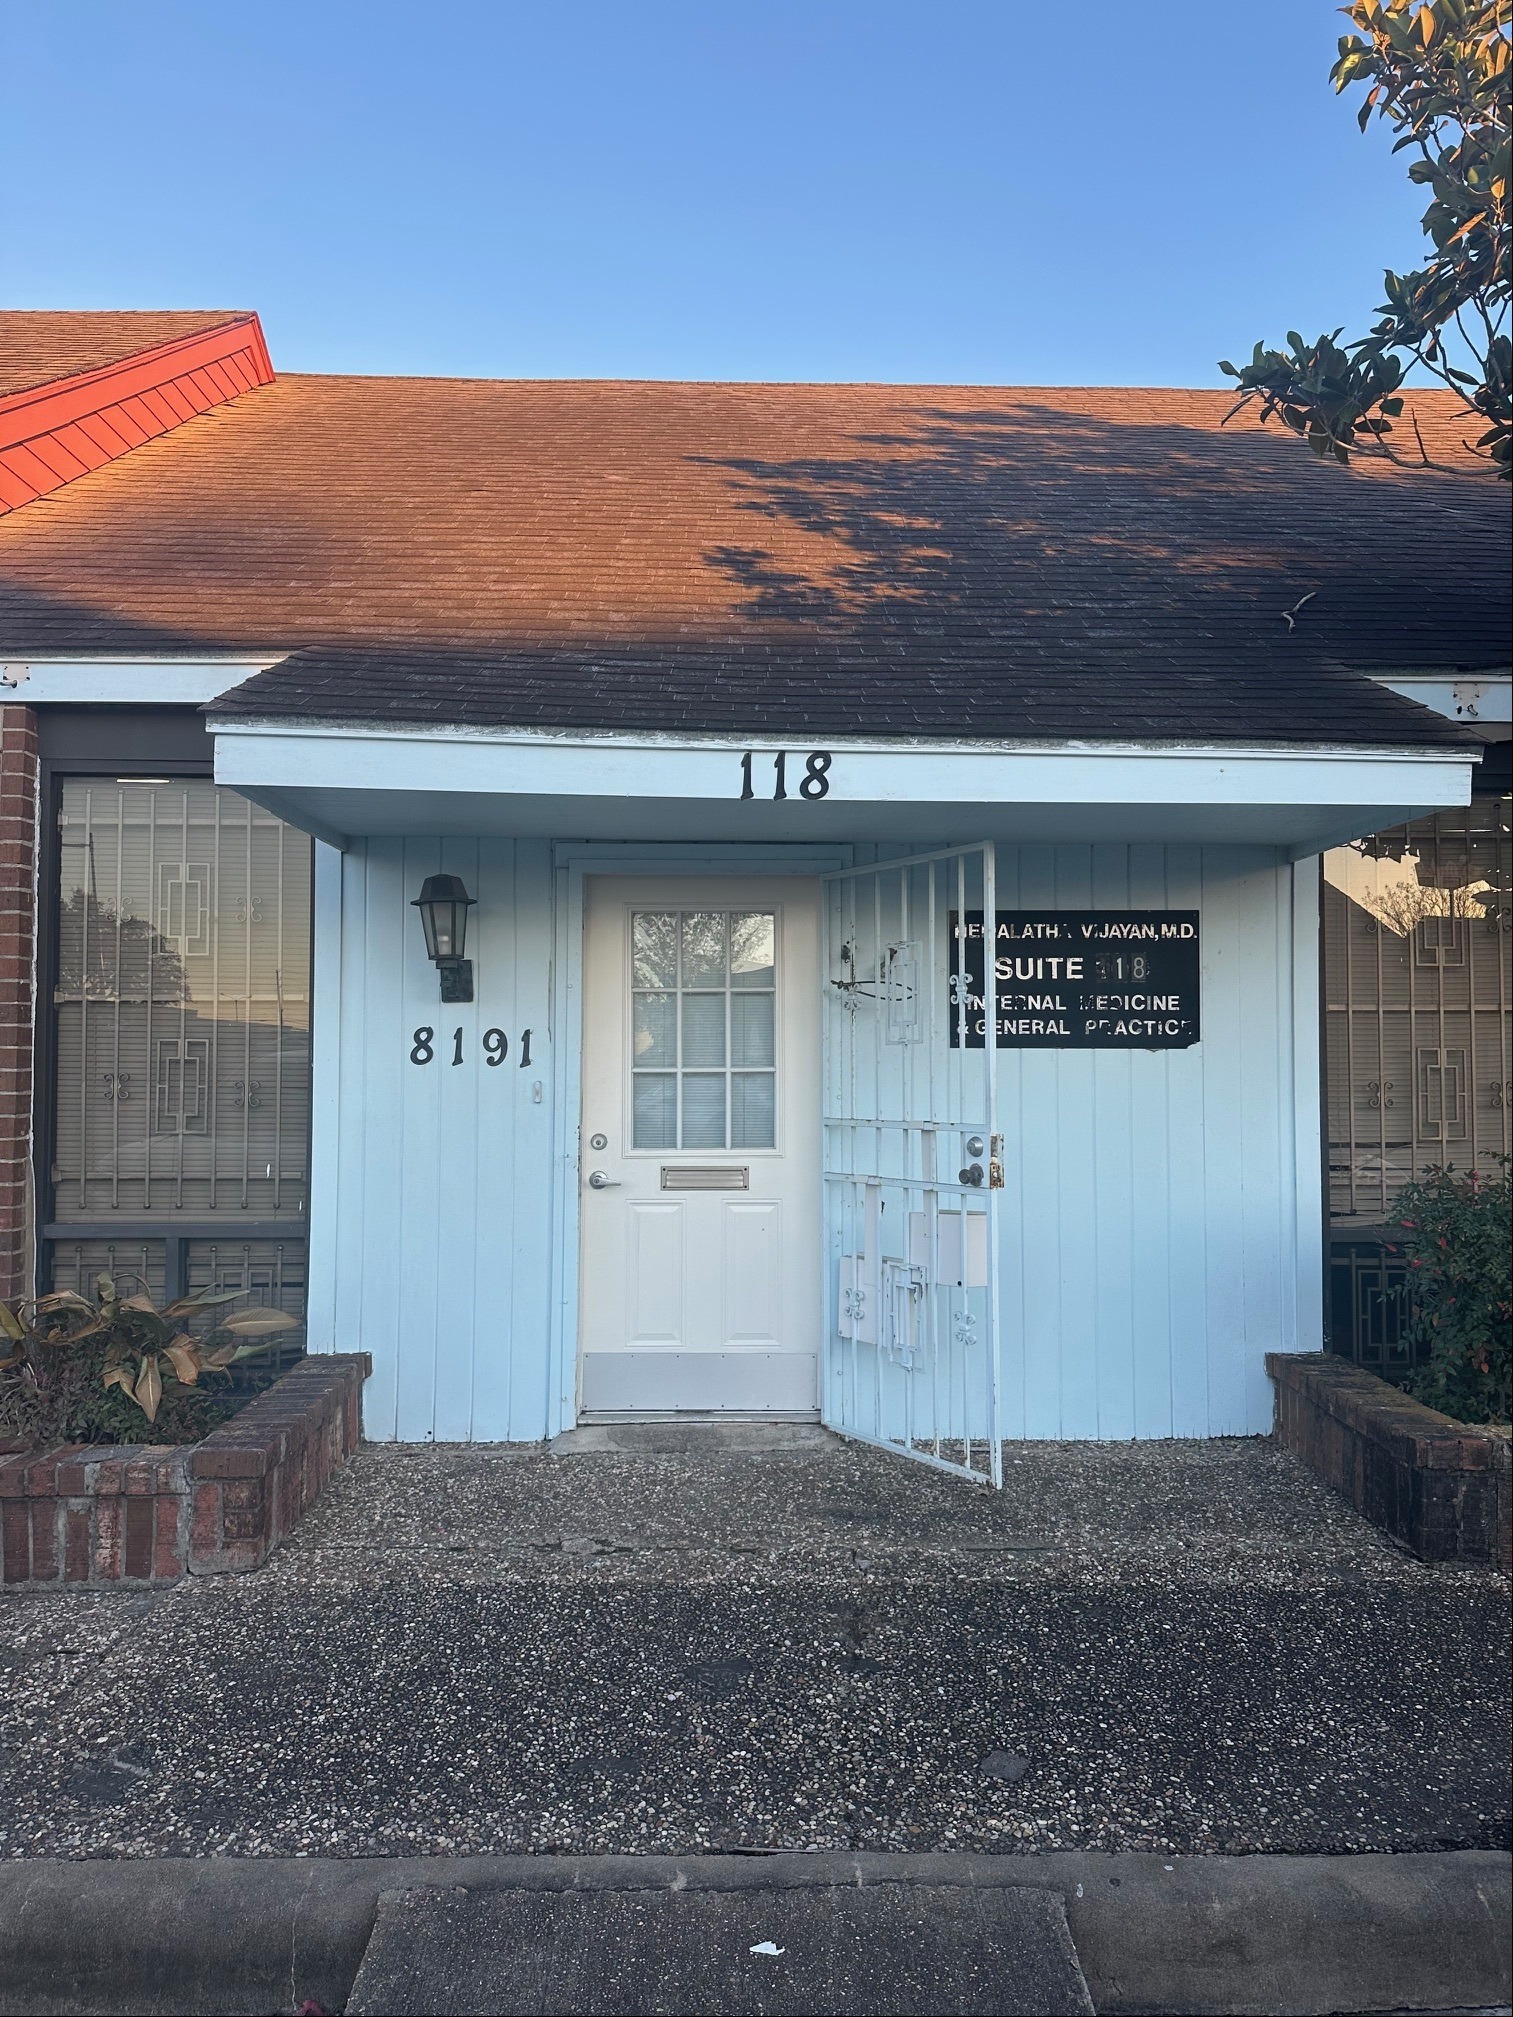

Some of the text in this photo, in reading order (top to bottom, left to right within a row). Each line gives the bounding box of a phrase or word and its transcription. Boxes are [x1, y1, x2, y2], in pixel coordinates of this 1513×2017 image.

[741, 750, 832, 801] 118
[995, 957, 1084, 980] SUITE
[410, 1026, 532, 1068] 8191
